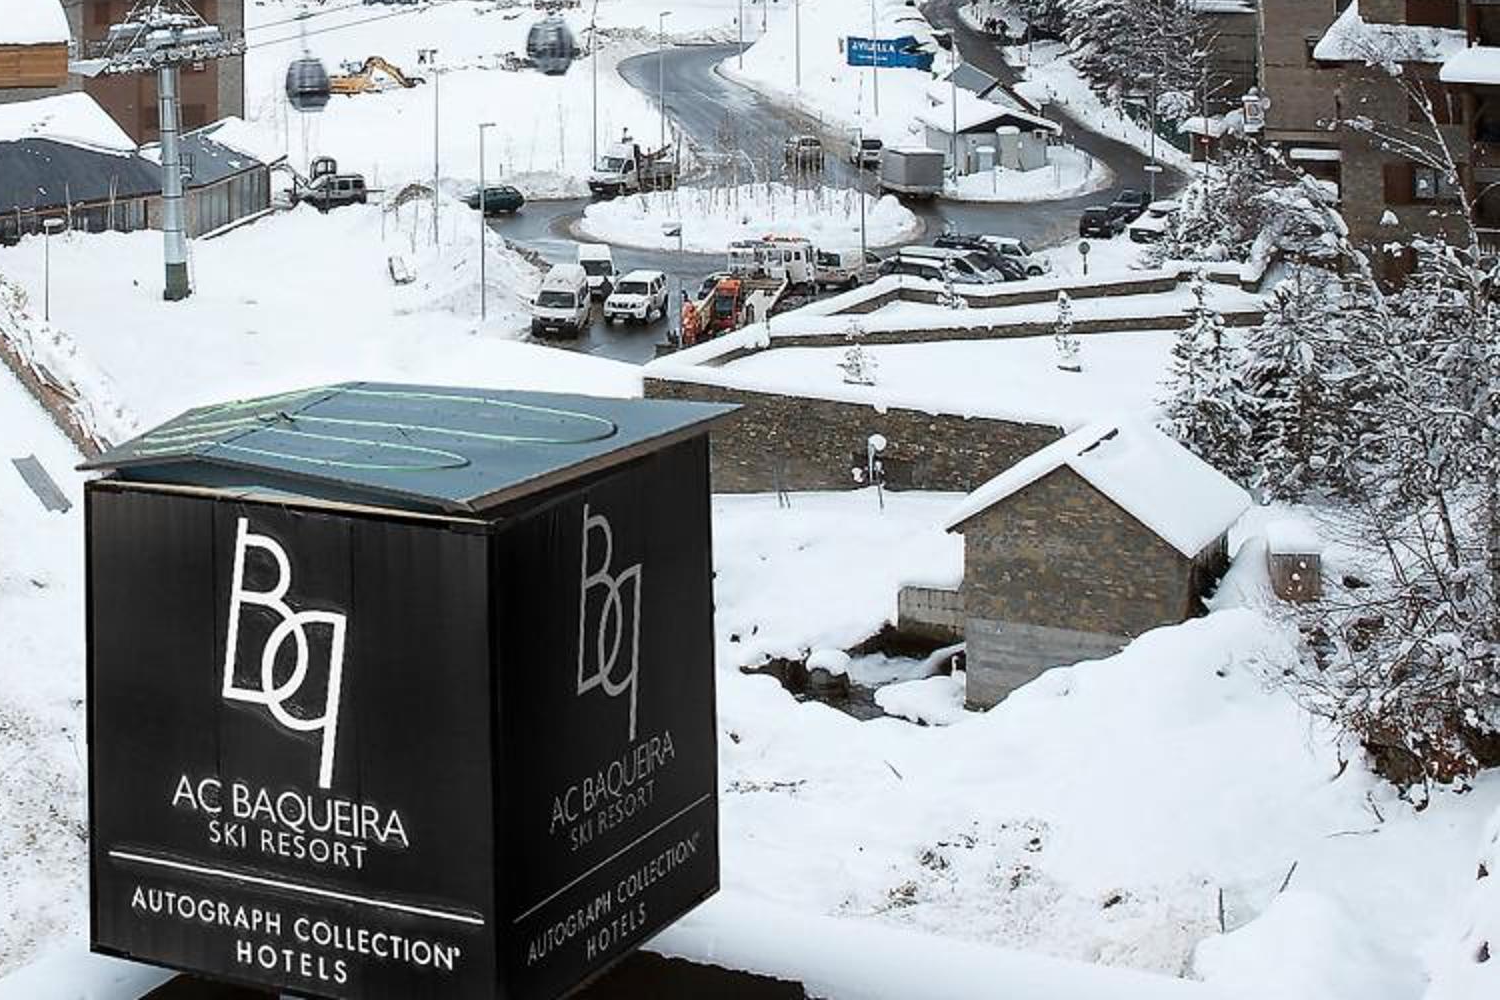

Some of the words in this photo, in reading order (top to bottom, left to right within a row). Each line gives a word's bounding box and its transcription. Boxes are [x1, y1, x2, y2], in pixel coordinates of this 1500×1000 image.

[172, 775, 223, 813] AC
[233, 783, 409, 848] BAQUEIRA
[550, 786, 579, 835] AC
[583, 730, 675, 812] BAQUEIRA
[570, 819, 595, 851] SKI
[598, 779, 655, 834] RESORT
[209, 820, 247, 848] SKI
[261, 829, 367, 870] RESORT
[131, 886, 282, 936] AUTOGRAPH
[526, 890, 612, 966] AUTOGRAPH
[587, 902, 646, 961] HOTELS
[237, 940, 348, 984] HOTELS
